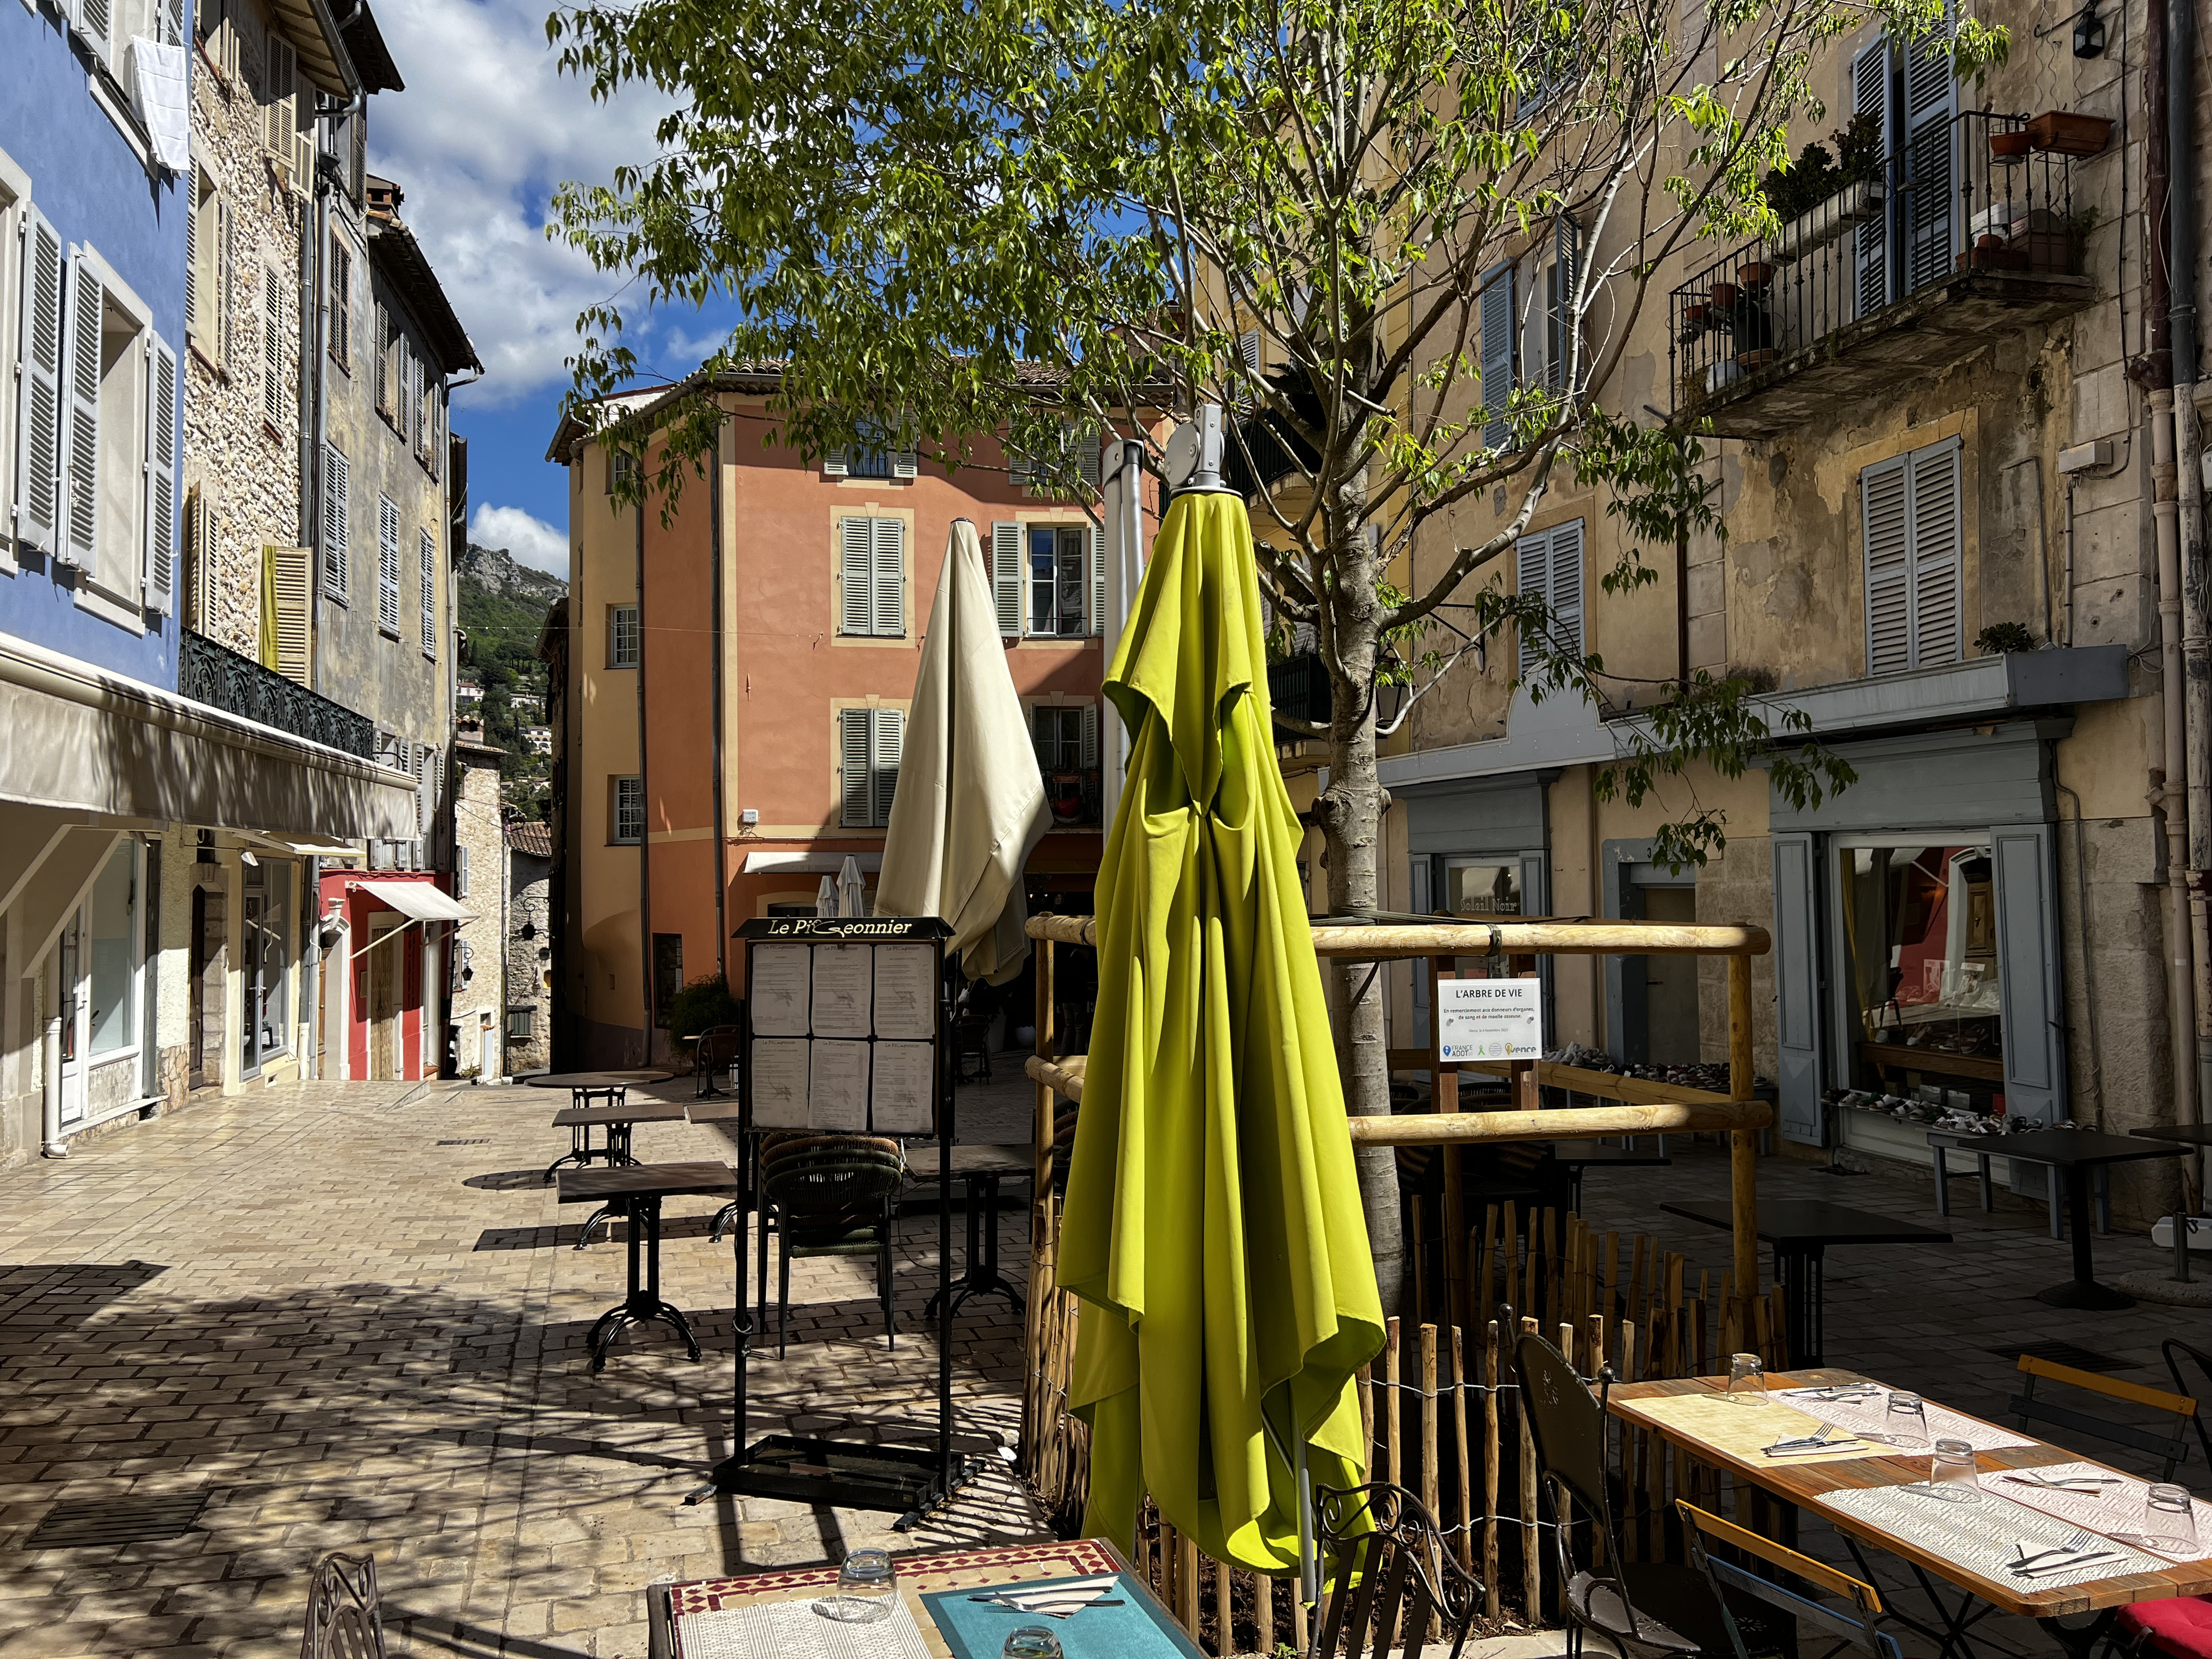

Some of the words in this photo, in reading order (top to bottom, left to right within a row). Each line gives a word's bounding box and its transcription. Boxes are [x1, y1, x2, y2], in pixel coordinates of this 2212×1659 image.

[1460, 895, 1489, 912] Soleil
[1491, 896, 1517, 912] Noir
[767, 919, 790, 935] Le
[1455, 989, 1492, 998] L'ARBRE
[1495, 989, 1506, 998] DE
[1508, 989, 1522, 997] VIE
